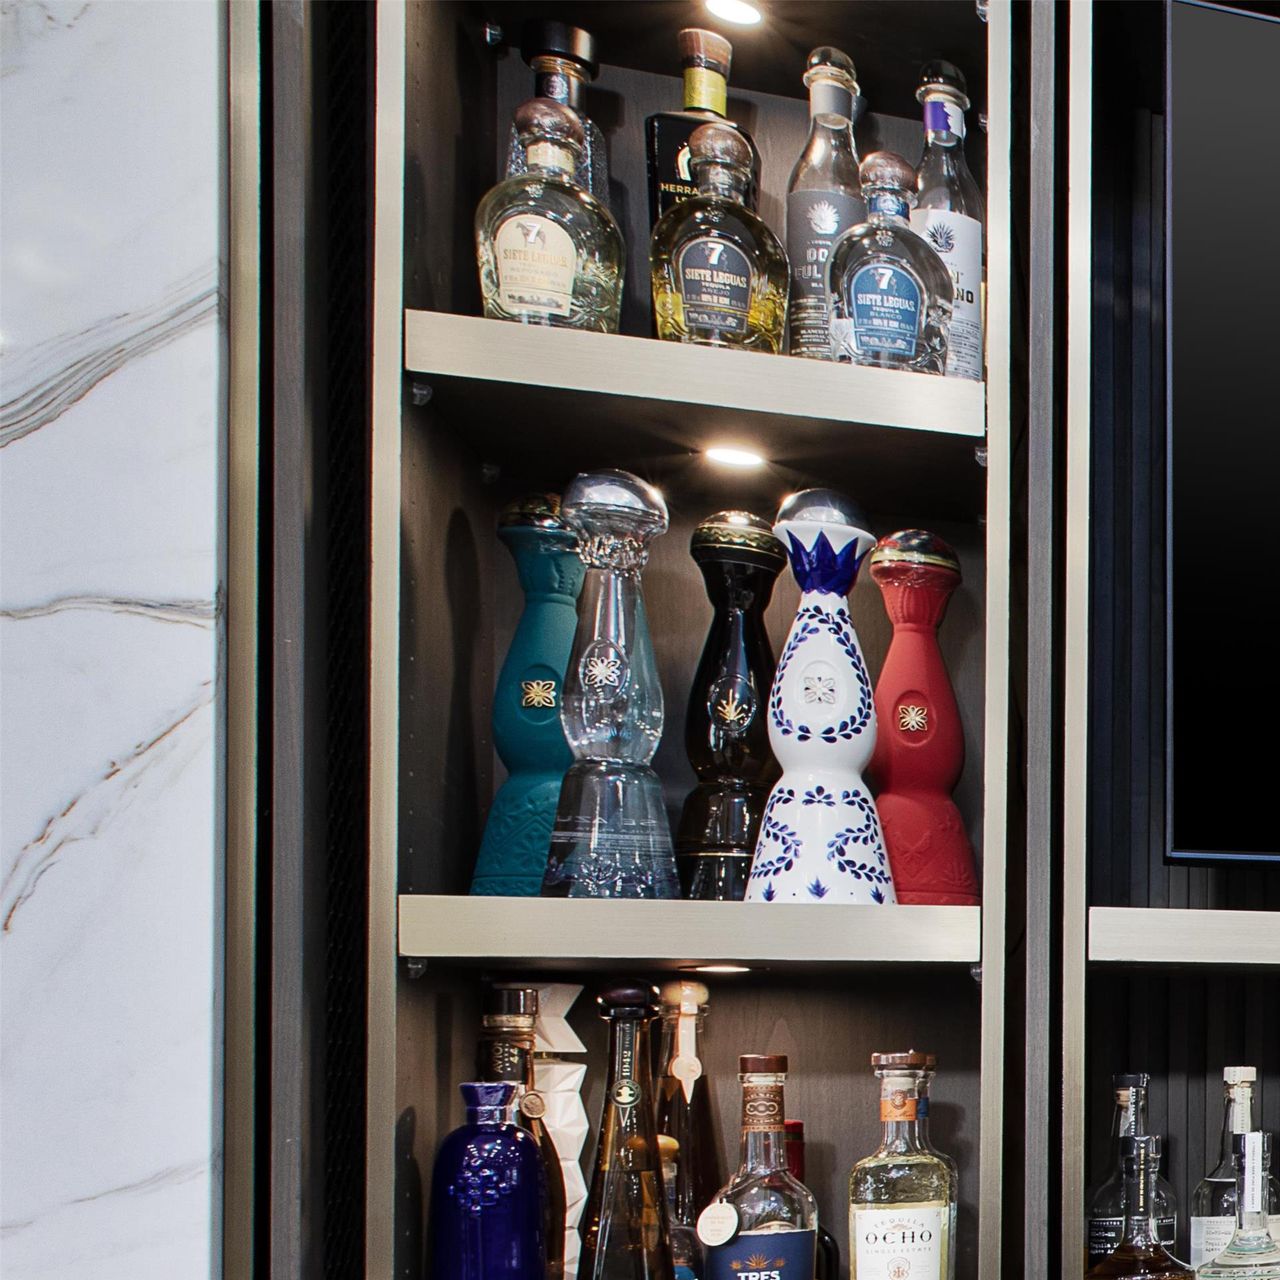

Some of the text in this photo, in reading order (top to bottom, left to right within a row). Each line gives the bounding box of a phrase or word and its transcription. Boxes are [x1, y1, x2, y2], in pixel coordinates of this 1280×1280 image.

[526, 222, 542, 244] 7
[707, 243, 724, 264] 7
[685, 268, 747, 288] SIETE LEGUAS
[876, 268, 893, 289] 7
[857, 293, 915, 312] SIETE LEGUAS
[874, 1216, 925, 1229] TEQUILA
[865, 1229, 933, 1245] OCHO
